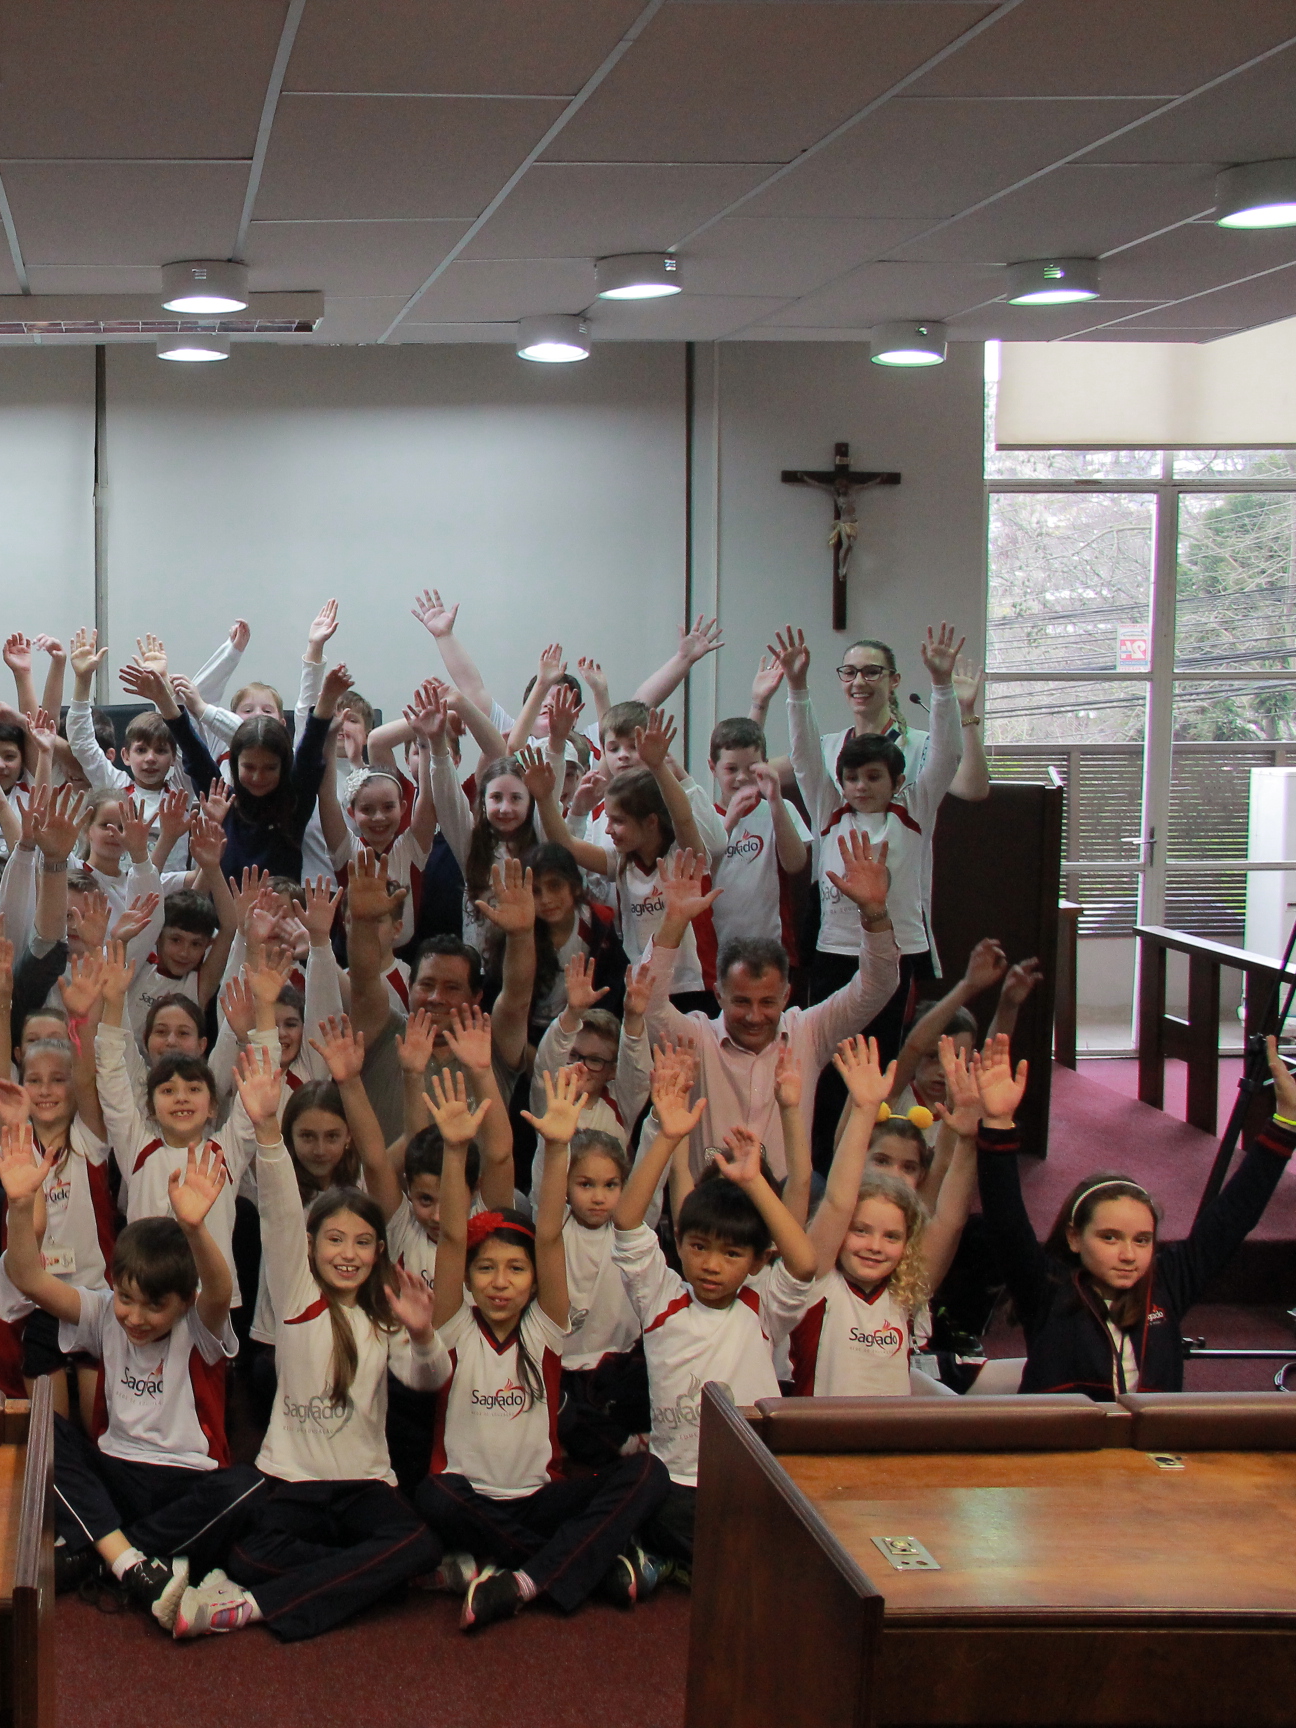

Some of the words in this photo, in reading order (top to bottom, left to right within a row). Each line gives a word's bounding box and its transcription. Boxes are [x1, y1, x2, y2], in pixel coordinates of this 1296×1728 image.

[849, 1327, 897, 1347] Sagrado
[471, 1389, 523, 1409] Sagrado
[283, 1395, 346, 1424] Sagrado
